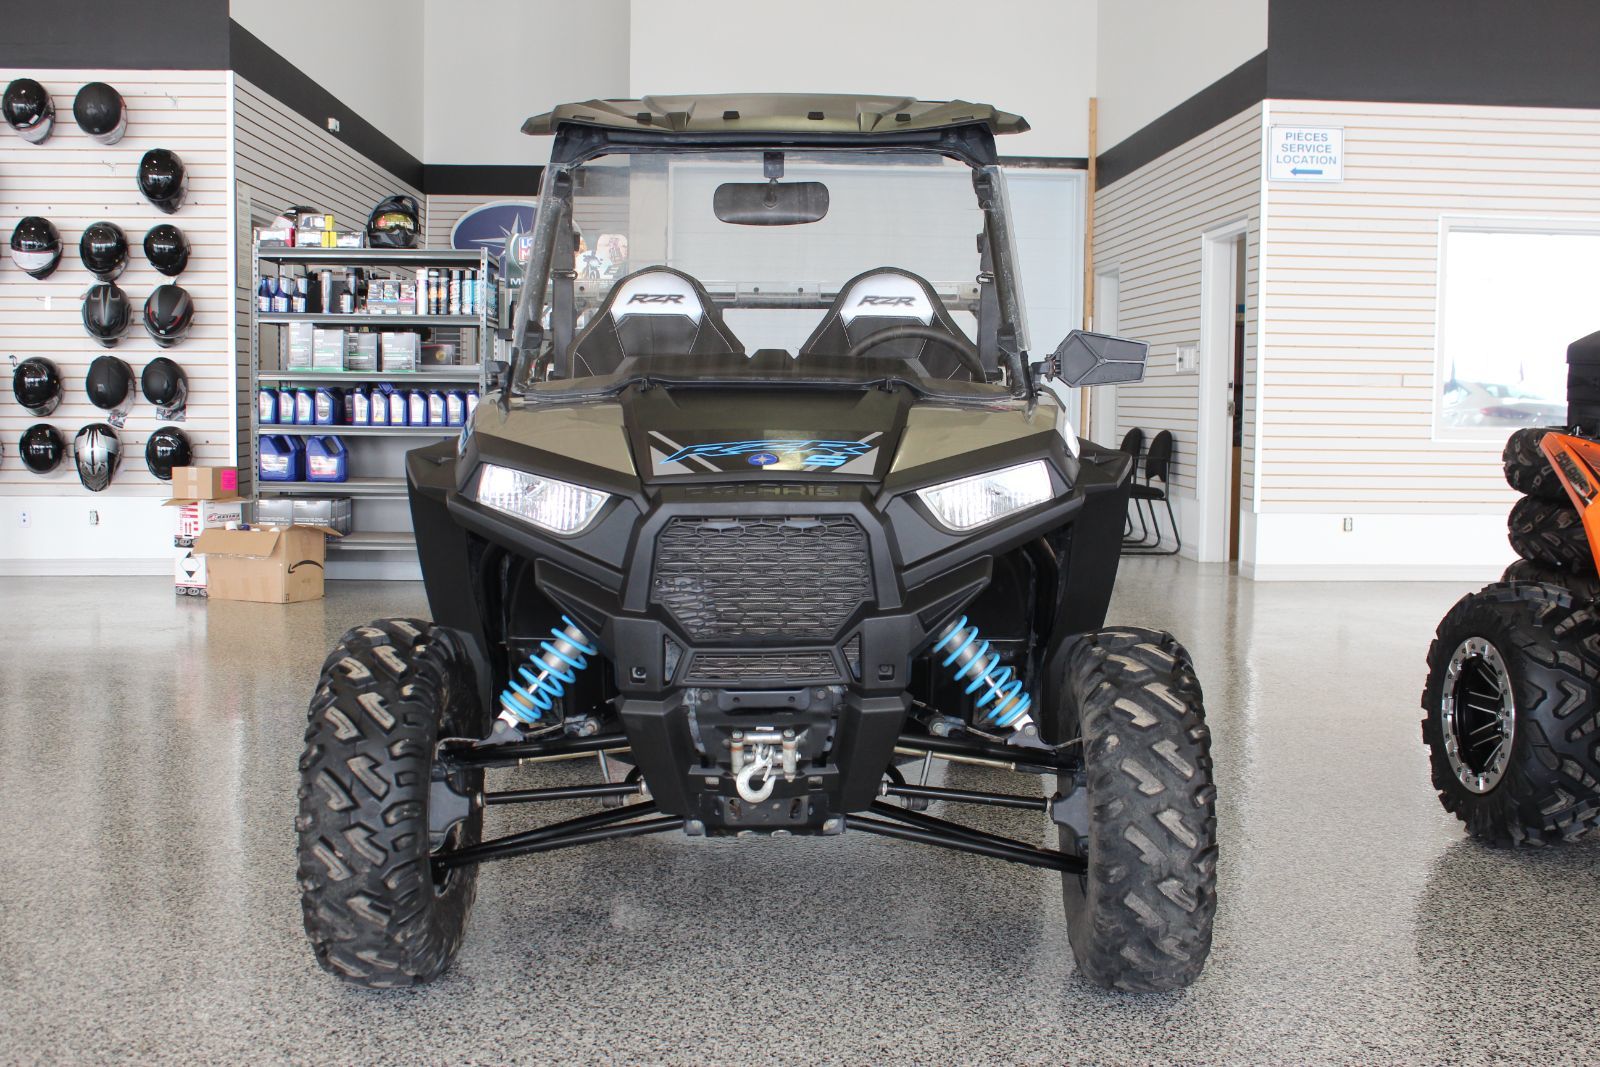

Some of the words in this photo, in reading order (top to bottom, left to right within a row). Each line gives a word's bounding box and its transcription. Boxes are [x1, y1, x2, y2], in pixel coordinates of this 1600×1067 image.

[1281, 143, 1332, 154] SERVICE
[1276, 154, 1337, 165] LOCATION
[626, 293, 686, 305] RZR
[856, 295, 917, 307] RZR
